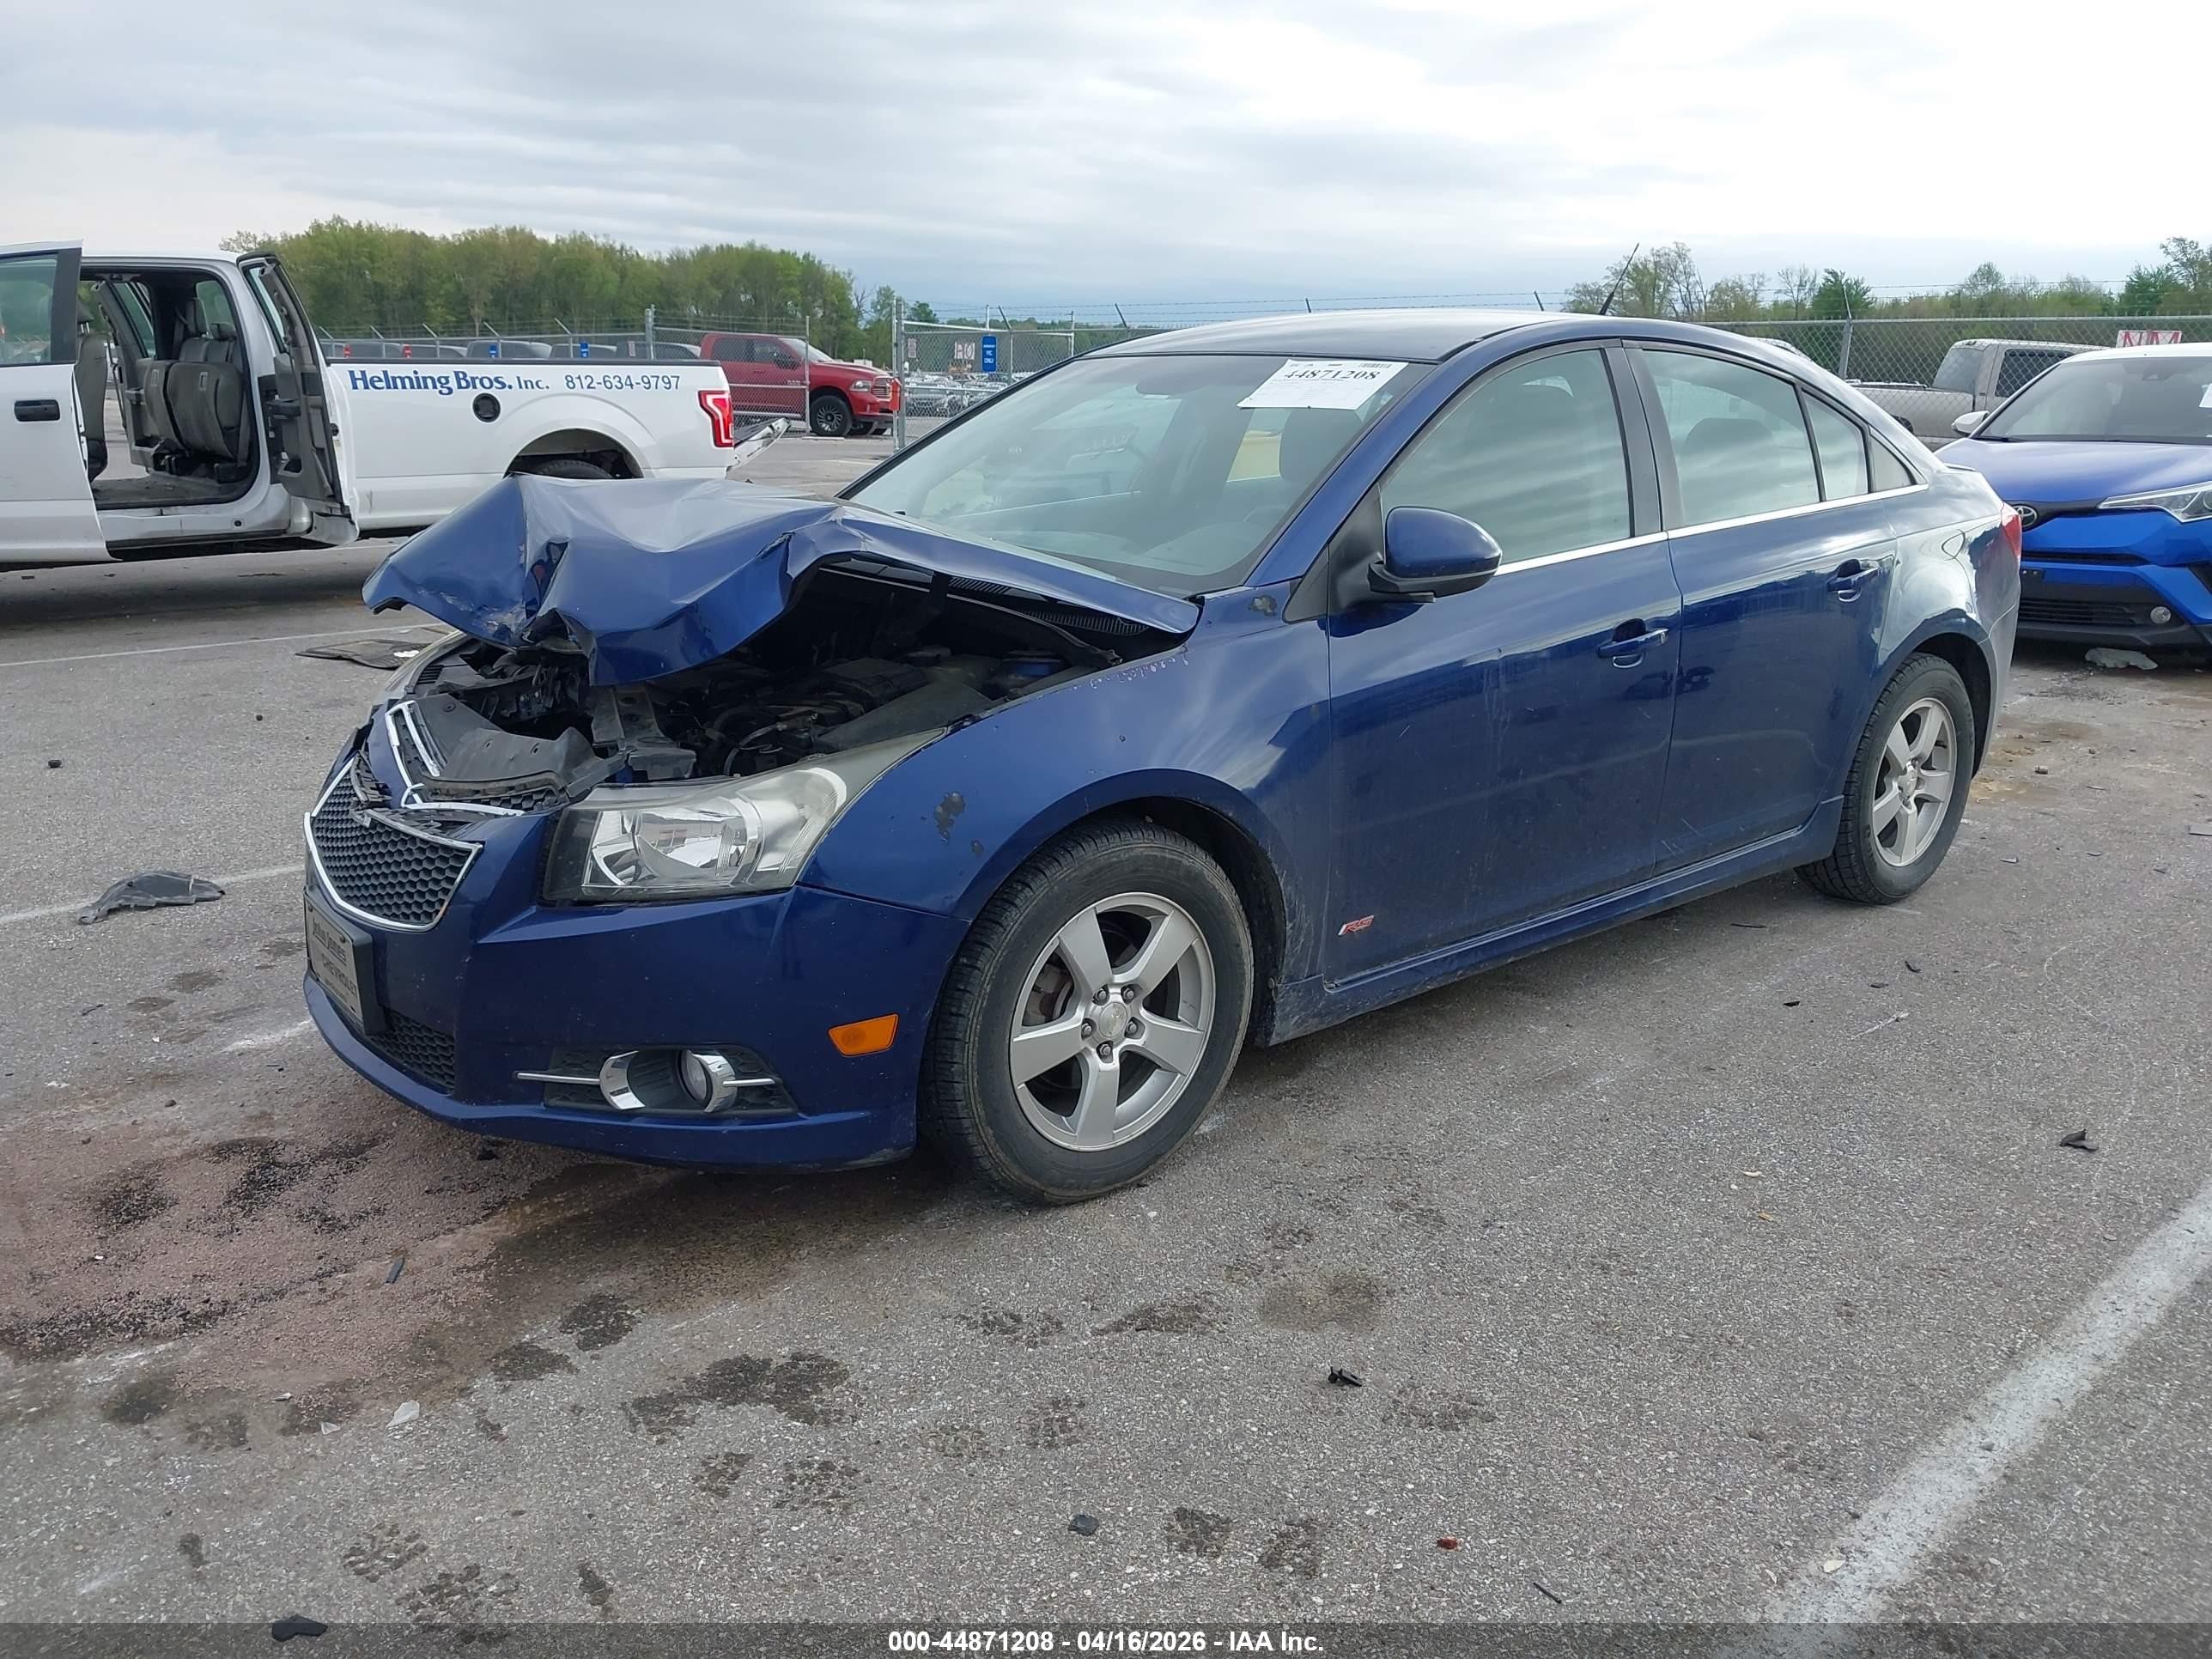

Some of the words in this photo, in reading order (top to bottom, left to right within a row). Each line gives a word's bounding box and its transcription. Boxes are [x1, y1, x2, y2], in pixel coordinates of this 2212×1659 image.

[348, 370, 454, 396] Helming
[453, 370, 514, 390] Bros.
[515, 376, 550, 390] Inc.
[564, 374, 681, 390] 812-634-9797
[1284, 369, 1381, 380] 44871208
